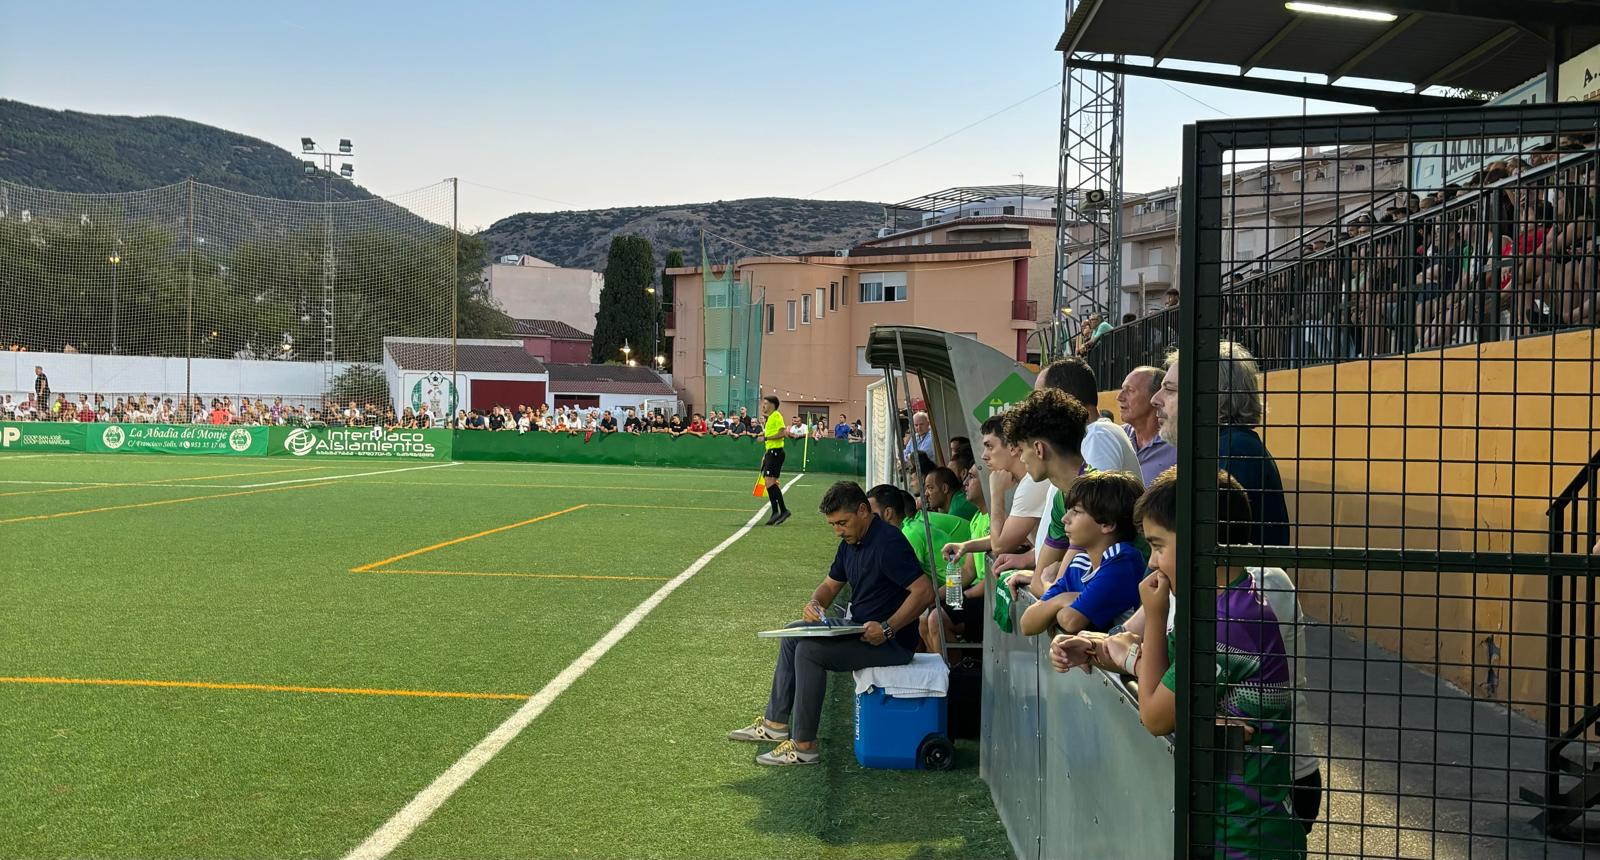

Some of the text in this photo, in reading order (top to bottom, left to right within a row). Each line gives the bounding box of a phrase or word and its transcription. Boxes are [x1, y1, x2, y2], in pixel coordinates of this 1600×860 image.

[129, 427, 142, 438] La
[181, 428, 194, 439] del
[197, 428, 228, 441] Monje
[316, 440, 435, 452] Aislamientos
